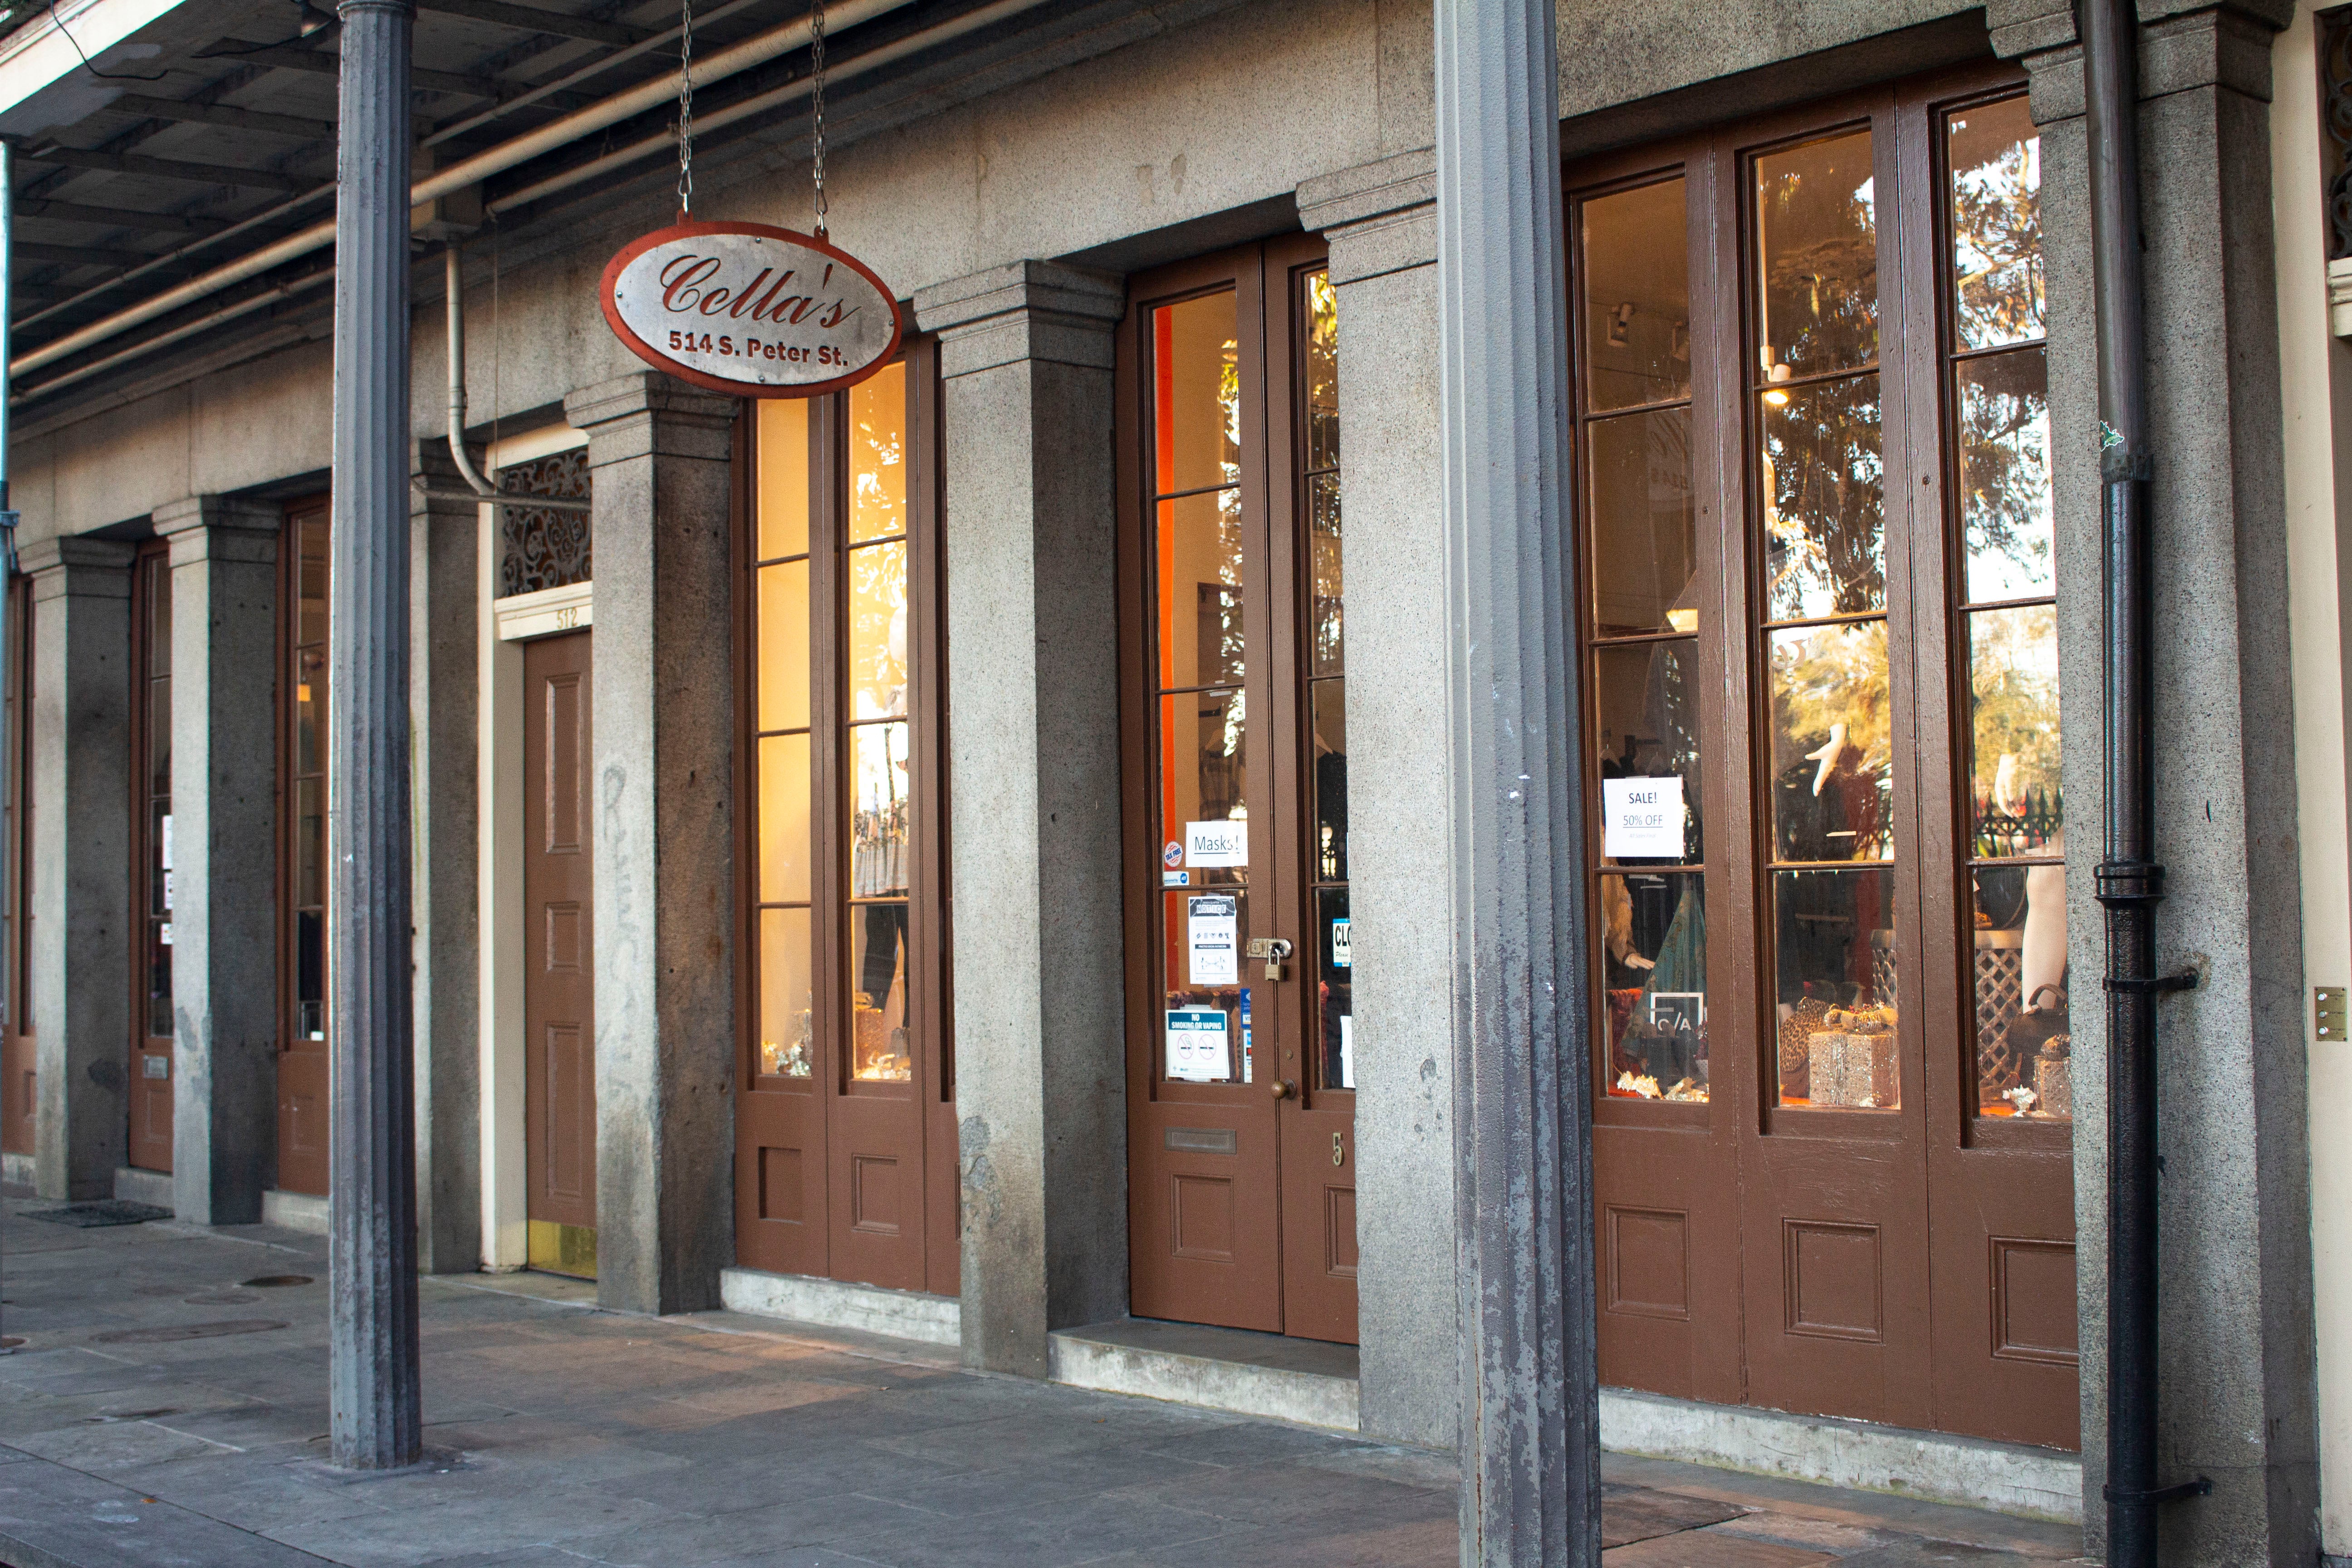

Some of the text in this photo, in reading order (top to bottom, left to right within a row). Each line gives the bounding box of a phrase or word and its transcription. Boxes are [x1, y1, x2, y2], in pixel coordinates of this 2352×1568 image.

[660, 255, 862, 328] Cella's
[669, 330, 848, 367] 514 S. Peter St.
[557, 608, 578, 629] 512
[1629, 792, 1656, 804] SALE!
[1623, 815, 1662, 825] 50% OFF
[1195, 835, 1238, 850] Masks!
[1173, 848, 1181, 857] FREE
[1333, 1132, 1342, 1166] 5
